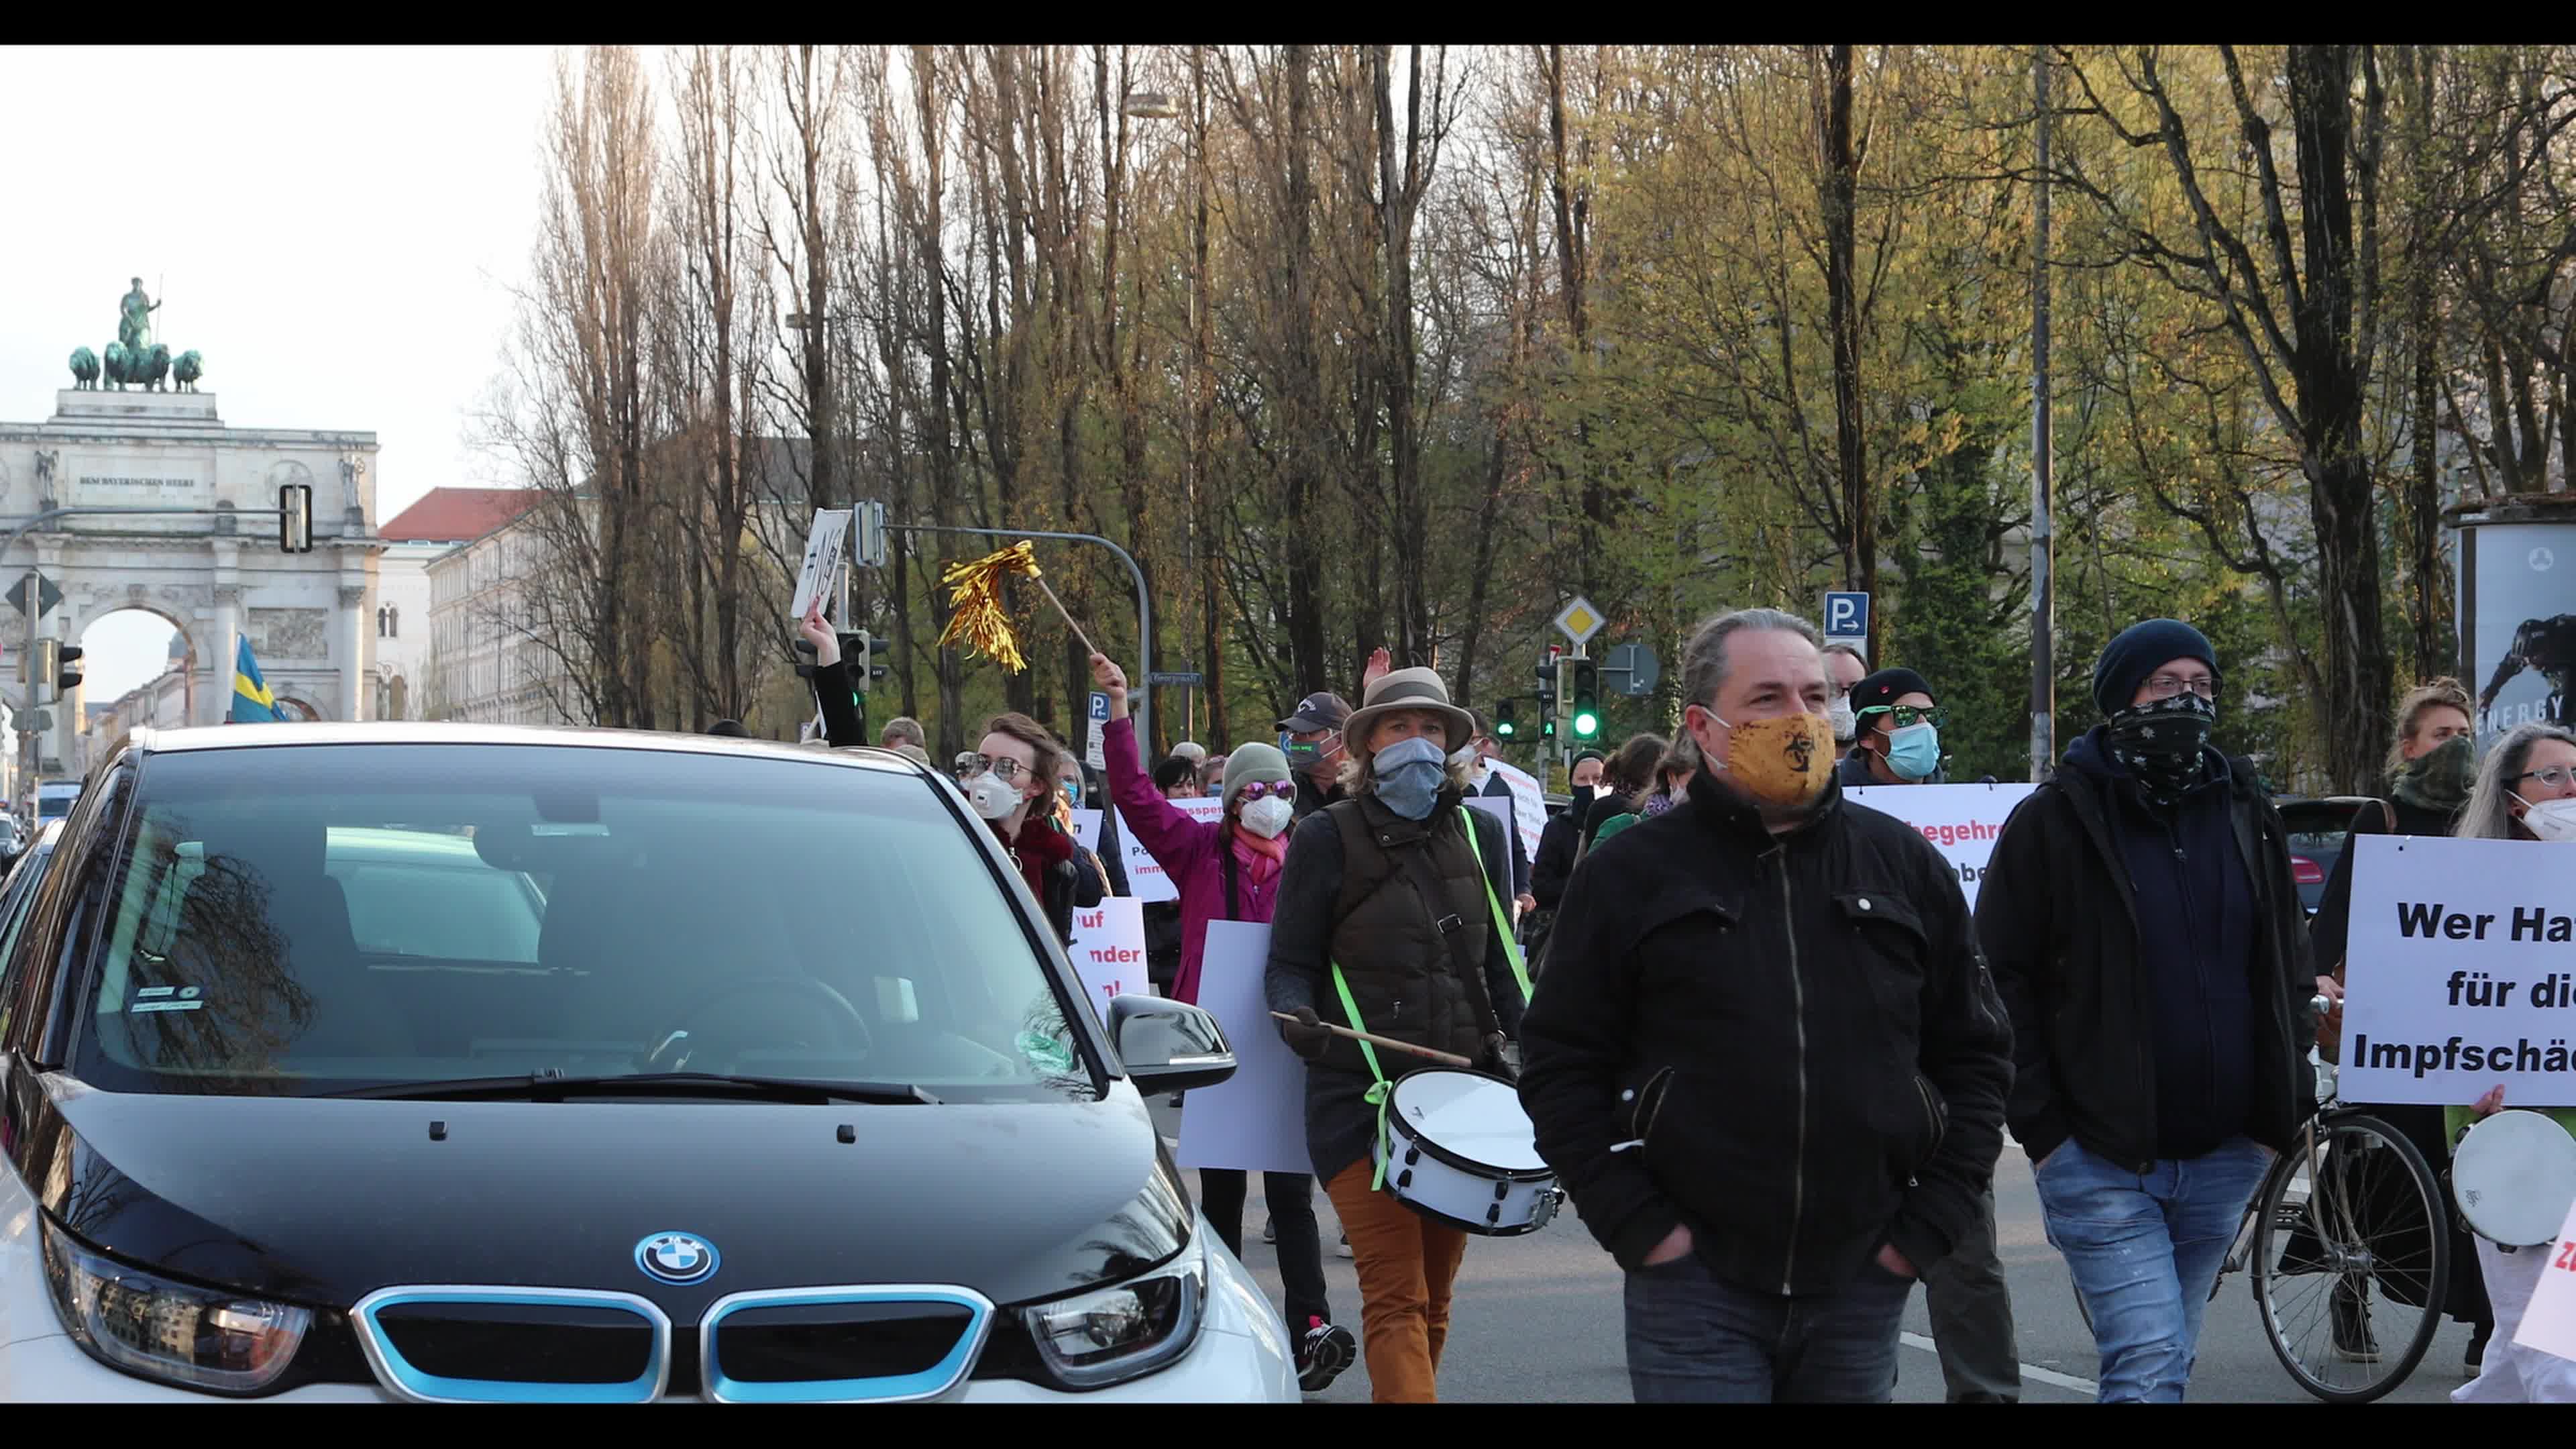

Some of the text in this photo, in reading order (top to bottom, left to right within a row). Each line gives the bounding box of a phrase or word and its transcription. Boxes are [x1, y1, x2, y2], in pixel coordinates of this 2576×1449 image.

[1832, 598, 1855, 631] P
[1091, 696, 1104, 716] P
[2475, 694, 2565, 736] ENERGY
[1076, 910, 1104, 928] uf
[2398, 902, 2576, 942] Wer Ha
[2447, 971, 2576, 1008] für di
[2354, 1034, 2576, 1078] Impfschä
[648, 1236, 704, 1250] BMW
